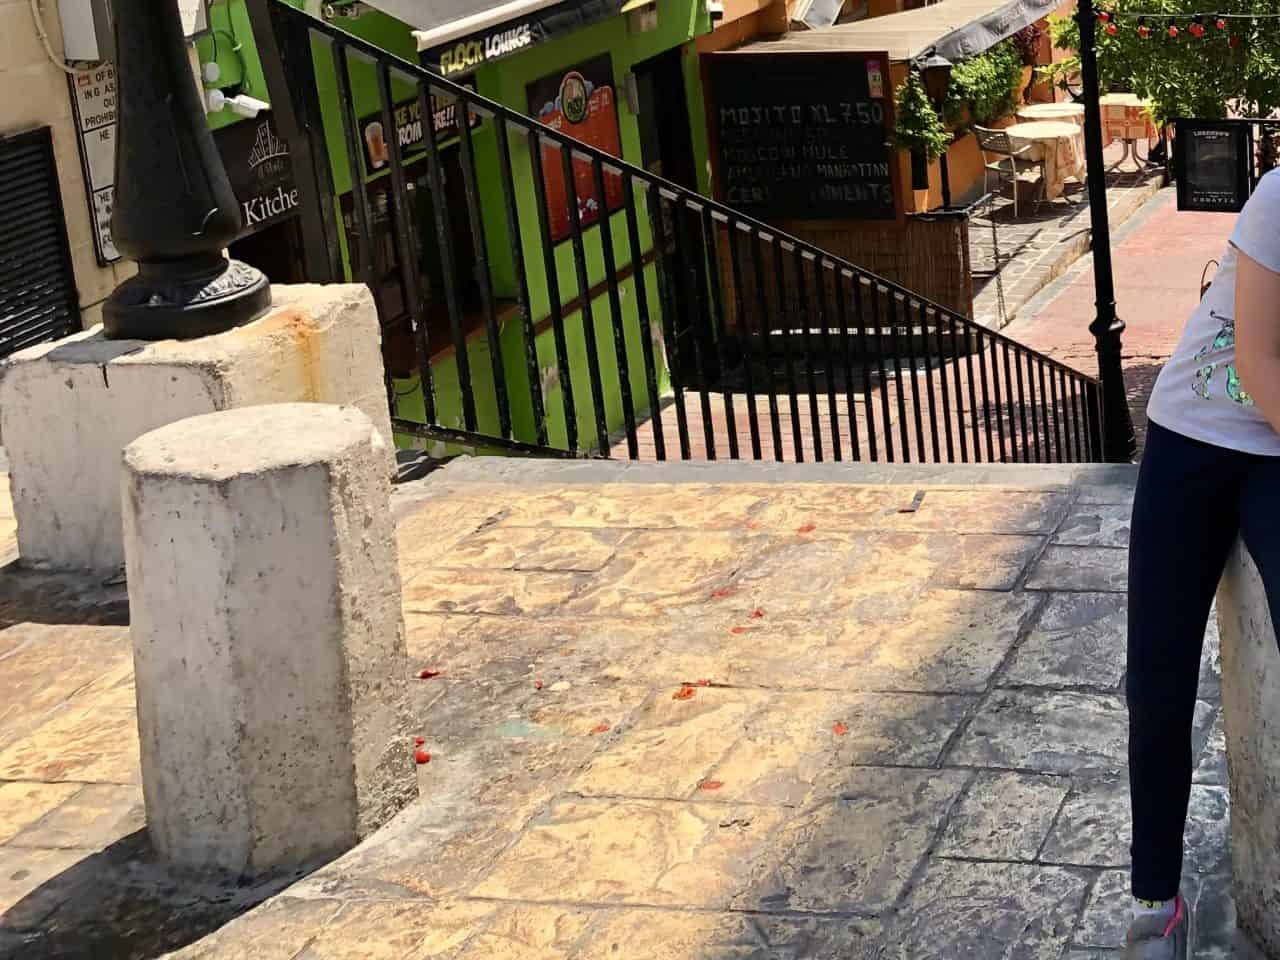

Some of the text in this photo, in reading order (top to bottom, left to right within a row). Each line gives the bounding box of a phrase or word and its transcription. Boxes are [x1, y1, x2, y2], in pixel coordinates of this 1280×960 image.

[440, 23, 532, 76] FLOCK LOUNGE
[85, 111, 114, 128] PROHIB
[243, 186, 299, 227] Kitche
